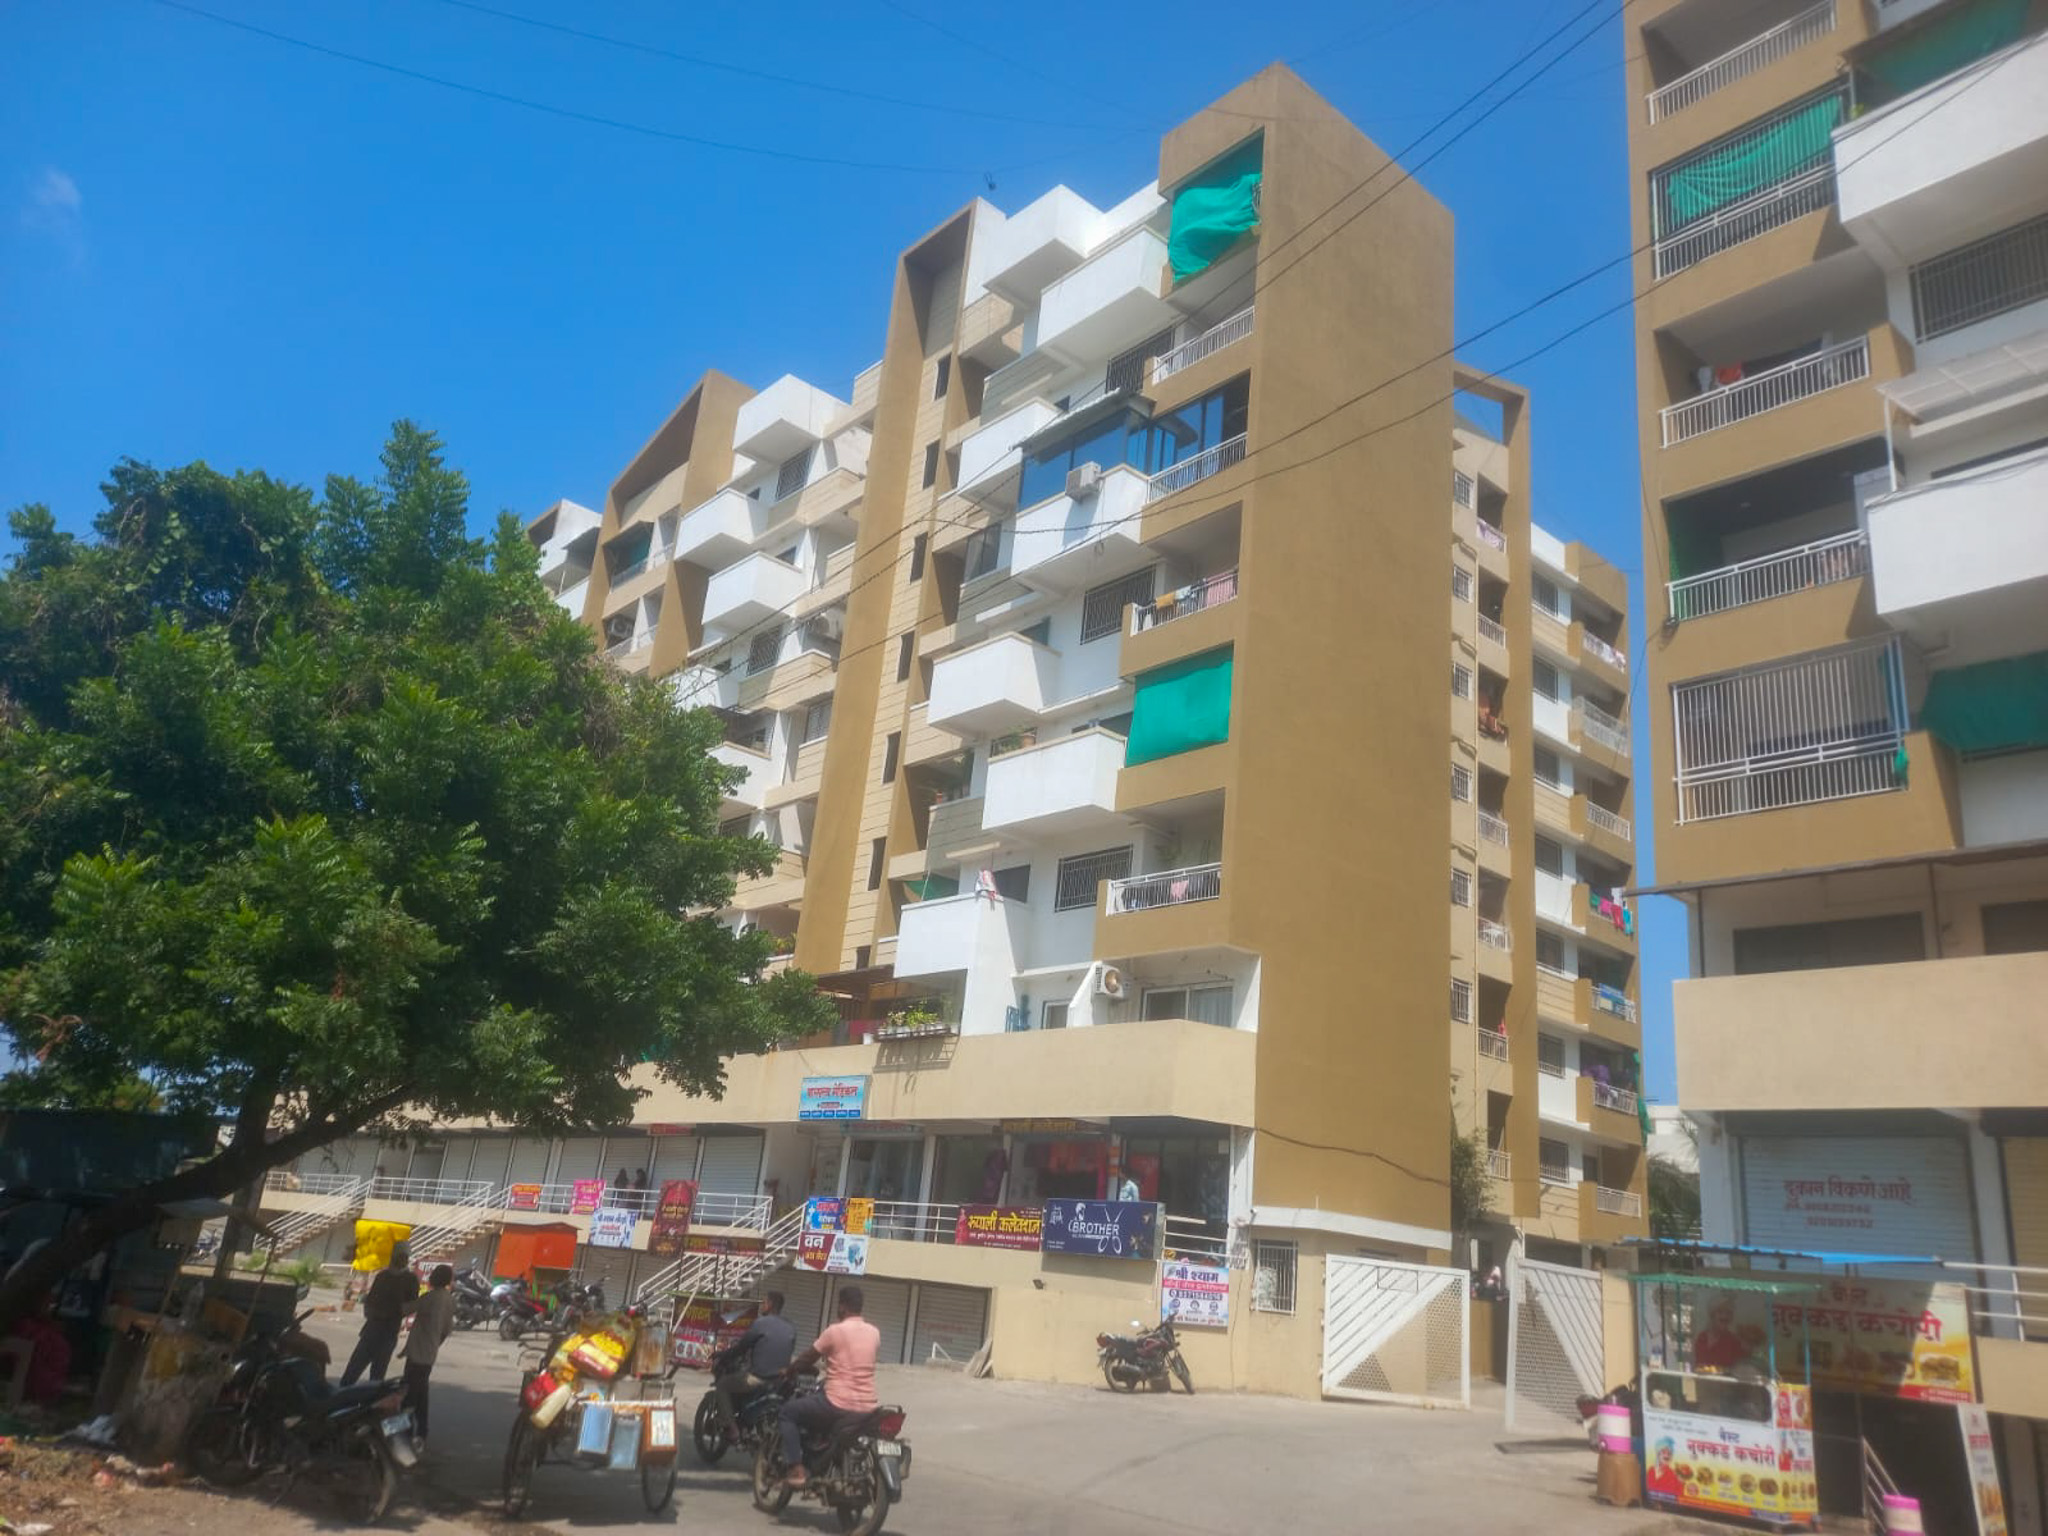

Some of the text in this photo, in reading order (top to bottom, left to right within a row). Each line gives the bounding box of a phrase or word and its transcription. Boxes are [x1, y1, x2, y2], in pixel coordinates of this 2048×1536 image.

[1072, 1221, 1120, 1235] BROTHER
[1175, 1266, 1219, 1283] श्री श्याम
[1734, 1443, 1776, 1466] कचोरी
